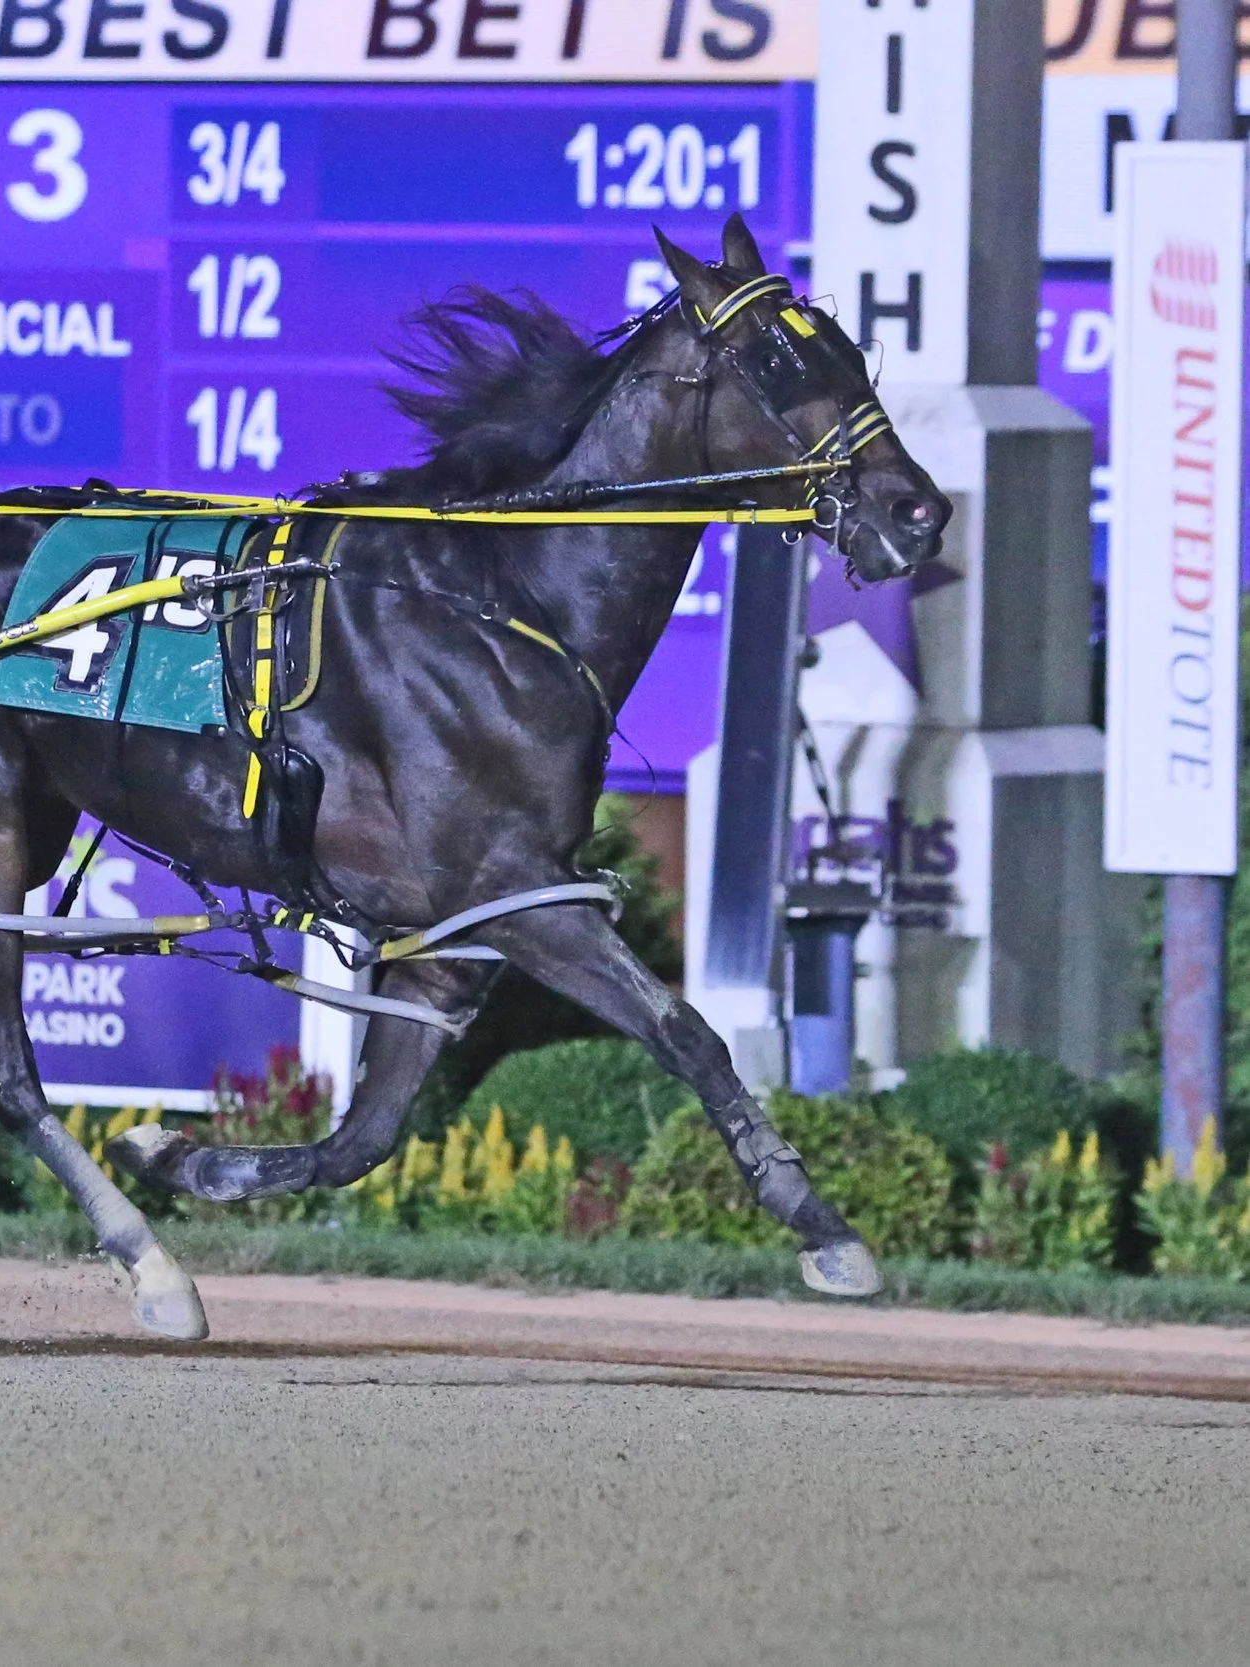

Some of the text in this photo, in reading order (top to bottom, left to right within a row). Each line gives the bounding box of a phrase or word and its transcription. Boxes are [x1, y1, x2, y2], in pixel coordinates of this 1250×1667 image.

[187, 121, 761, 210] 3/4 1:20:1
[187, 255, 282, 339] 1/2
[186, 387, 282, 471] 1/4
[40, 562, 118, 686] 4
[24, 962, 126, 1006] PARK
[26, 1010, 126, 1047] ASINO
